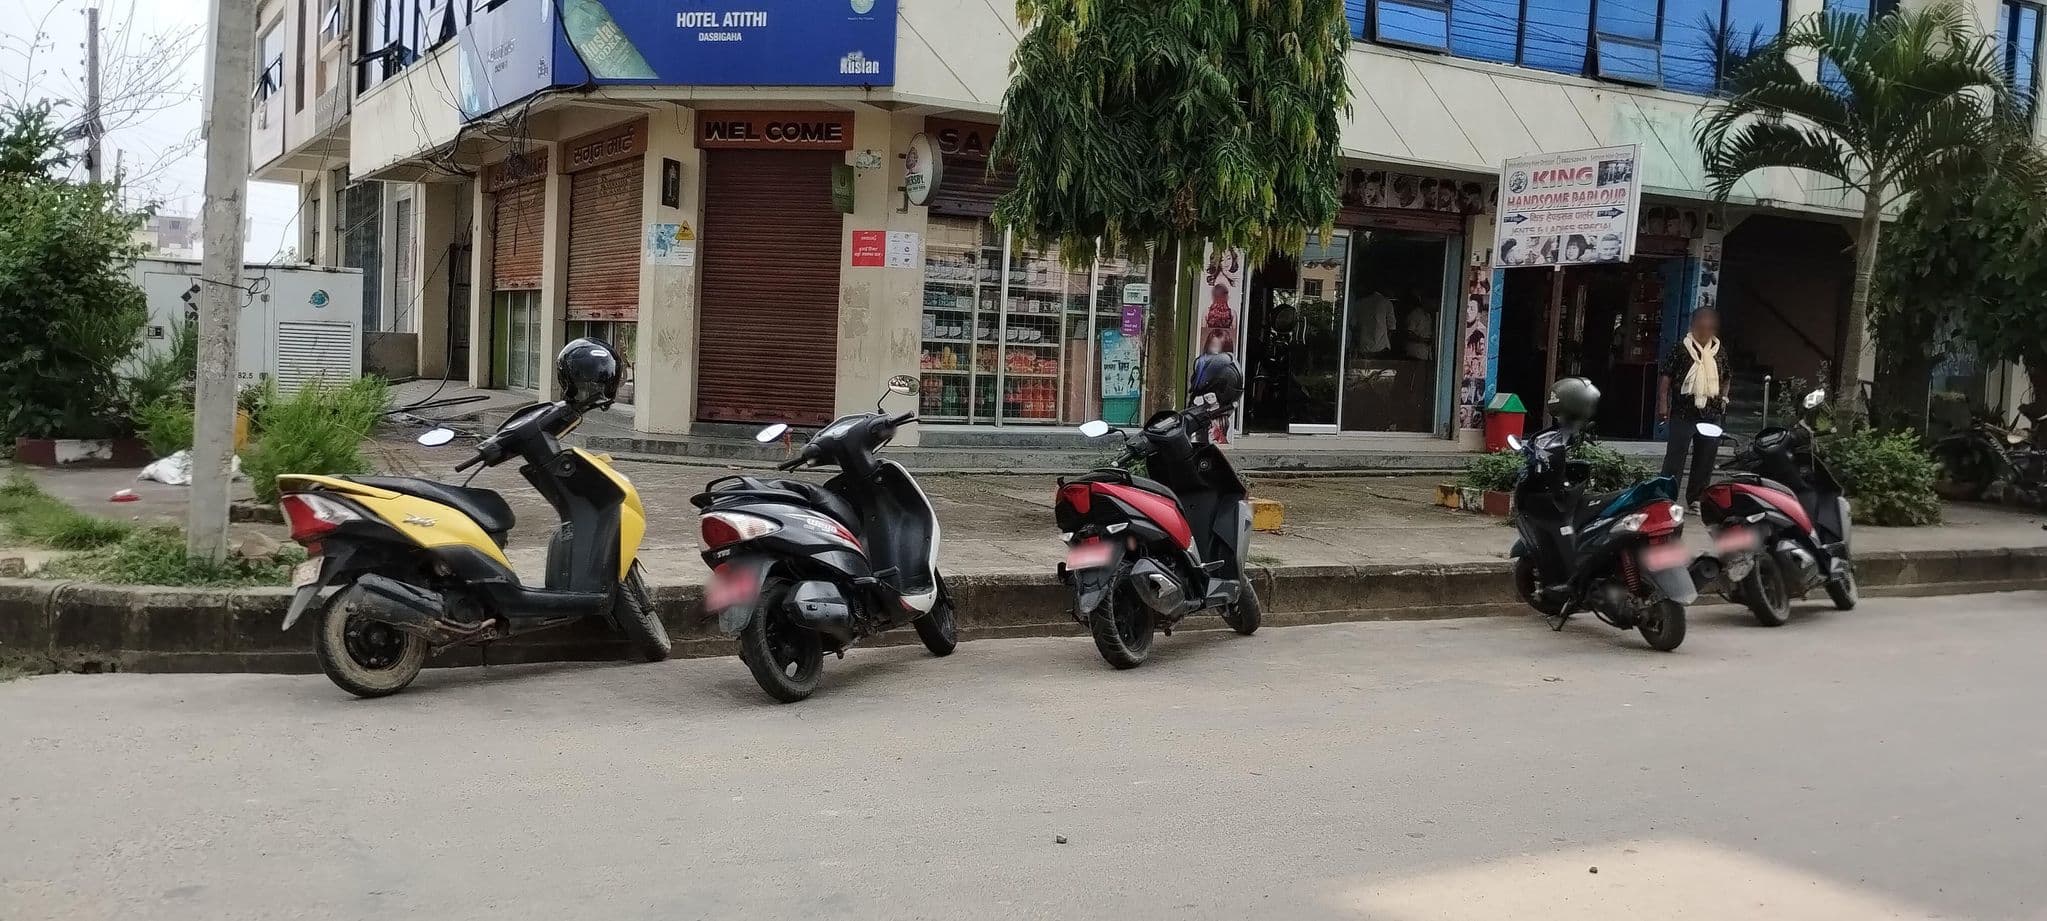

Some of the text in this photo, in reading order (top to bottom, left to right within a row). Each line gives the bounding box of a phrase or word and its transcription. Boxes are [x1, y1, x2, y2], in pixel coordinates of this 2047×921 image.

[676, 12, 767, 28] HOTEL ATITHI
[698, 32, 742, 42] DASBIGAHA
[765, 121, 842, 143] COME
[1532, 166, 1593, 189] KING
[1507, 187, 1627, 211] HANDSOME PARLOUR
